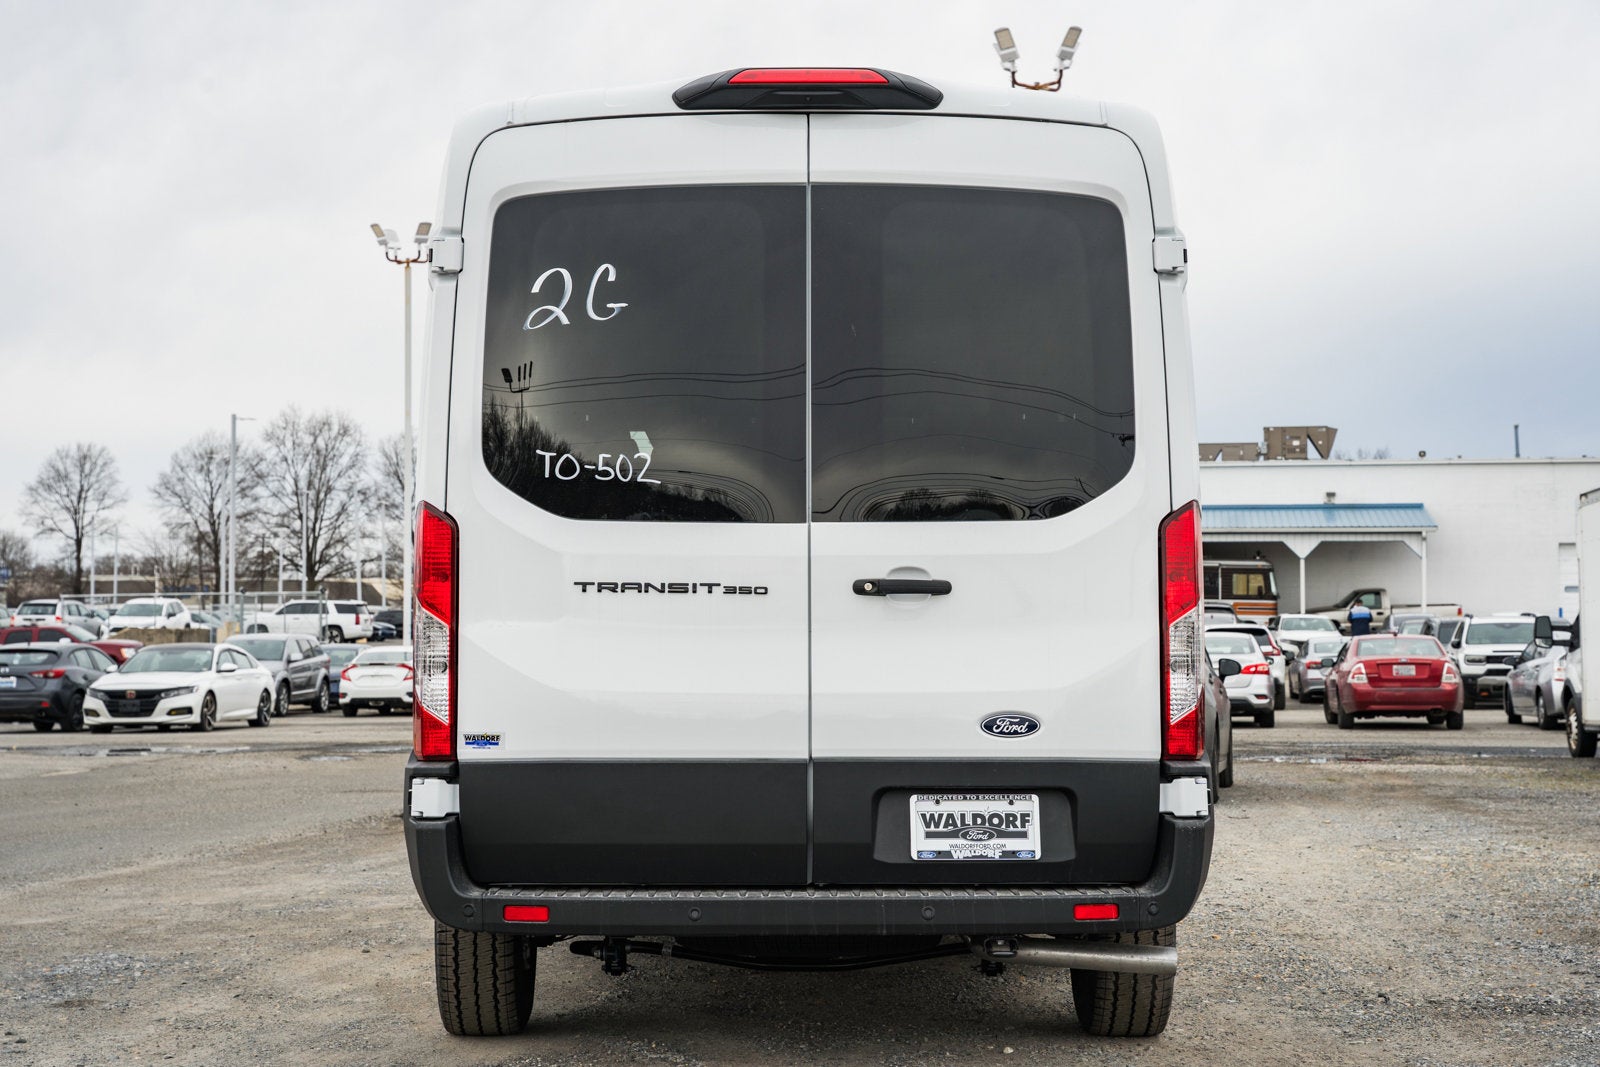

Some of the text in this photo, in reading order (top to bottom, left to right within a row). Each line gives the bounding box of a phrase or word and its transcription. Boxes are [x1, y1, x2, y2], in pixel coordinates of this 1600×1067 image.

[535, 449, 662, 484] TO-502
[918, 811, 1031, 829] WALDORF
[966, 829, 990, 840] Ford
[950, 849, 1002, 859] WALDORF
